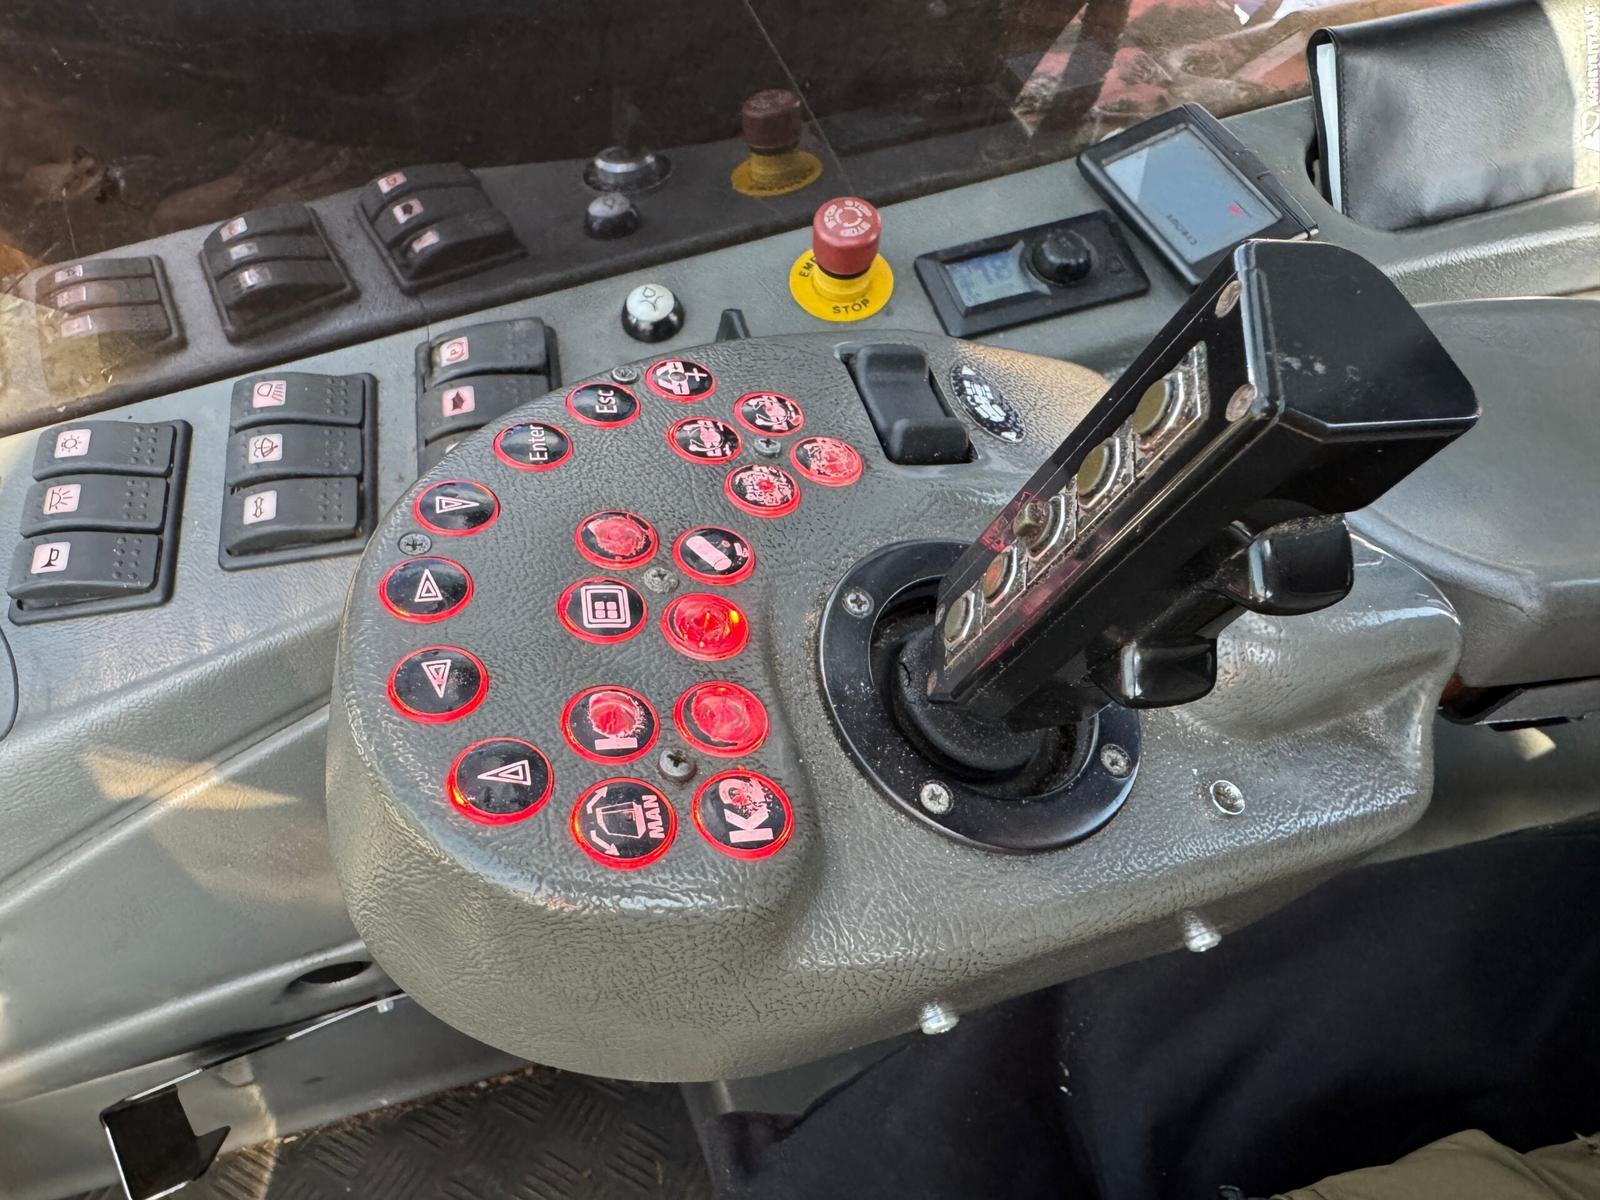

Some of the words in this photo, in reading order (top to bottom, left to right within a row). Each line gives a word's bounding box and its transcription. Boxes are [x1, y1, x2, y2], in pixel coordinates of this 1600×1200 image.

[831, 298, 870, 315] STOP
[595, 389, 618, 414] Esc
[528, 424, 548, 461] Enter
[641, 794, 666, 839] MAN
